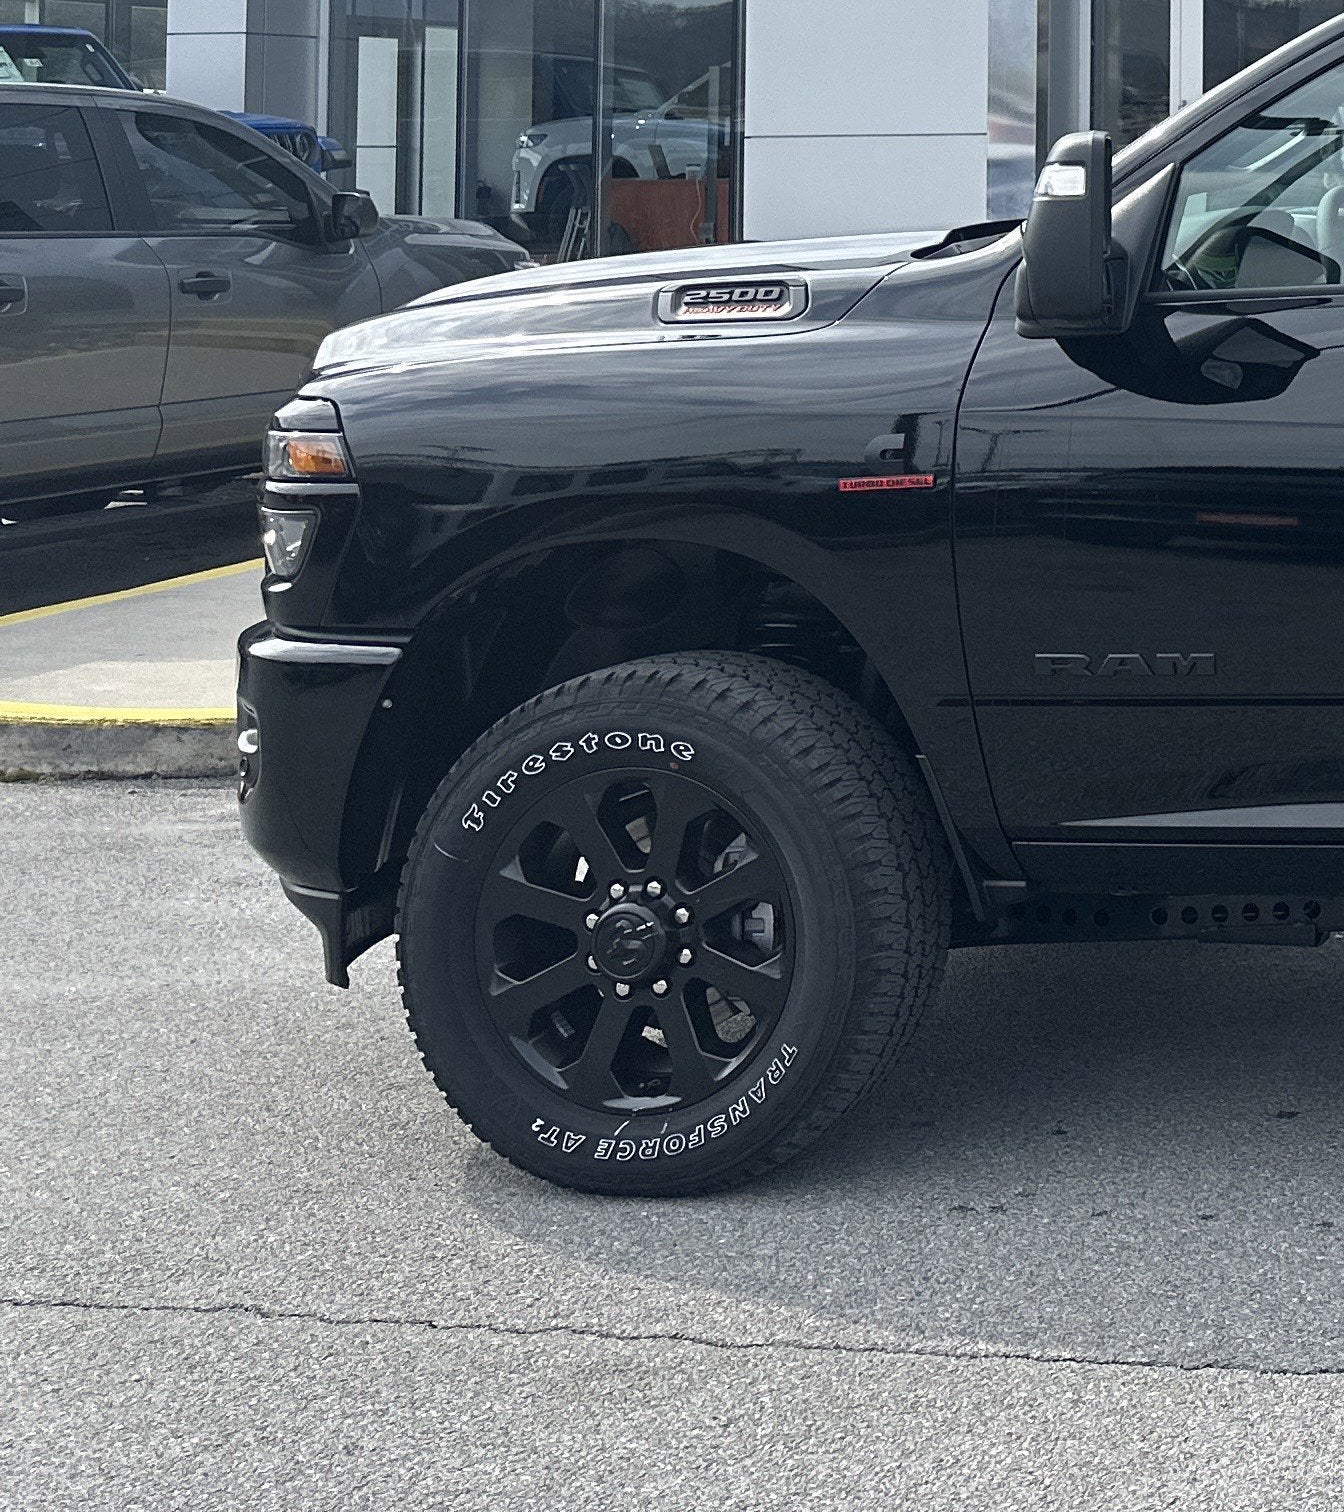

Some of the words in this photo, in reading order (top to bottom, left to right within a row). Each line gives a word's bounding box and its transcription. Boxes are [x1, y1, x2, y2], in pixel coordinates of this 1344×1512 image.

[683, 287, 782, 304] 2500
[735, 303, 782, 313] DUTY
[1034, 652, 1216, 677] RAM
[461, 731, 695, 832] Firestone
[593, 1042, 797, 1161] TRANSFORCE
